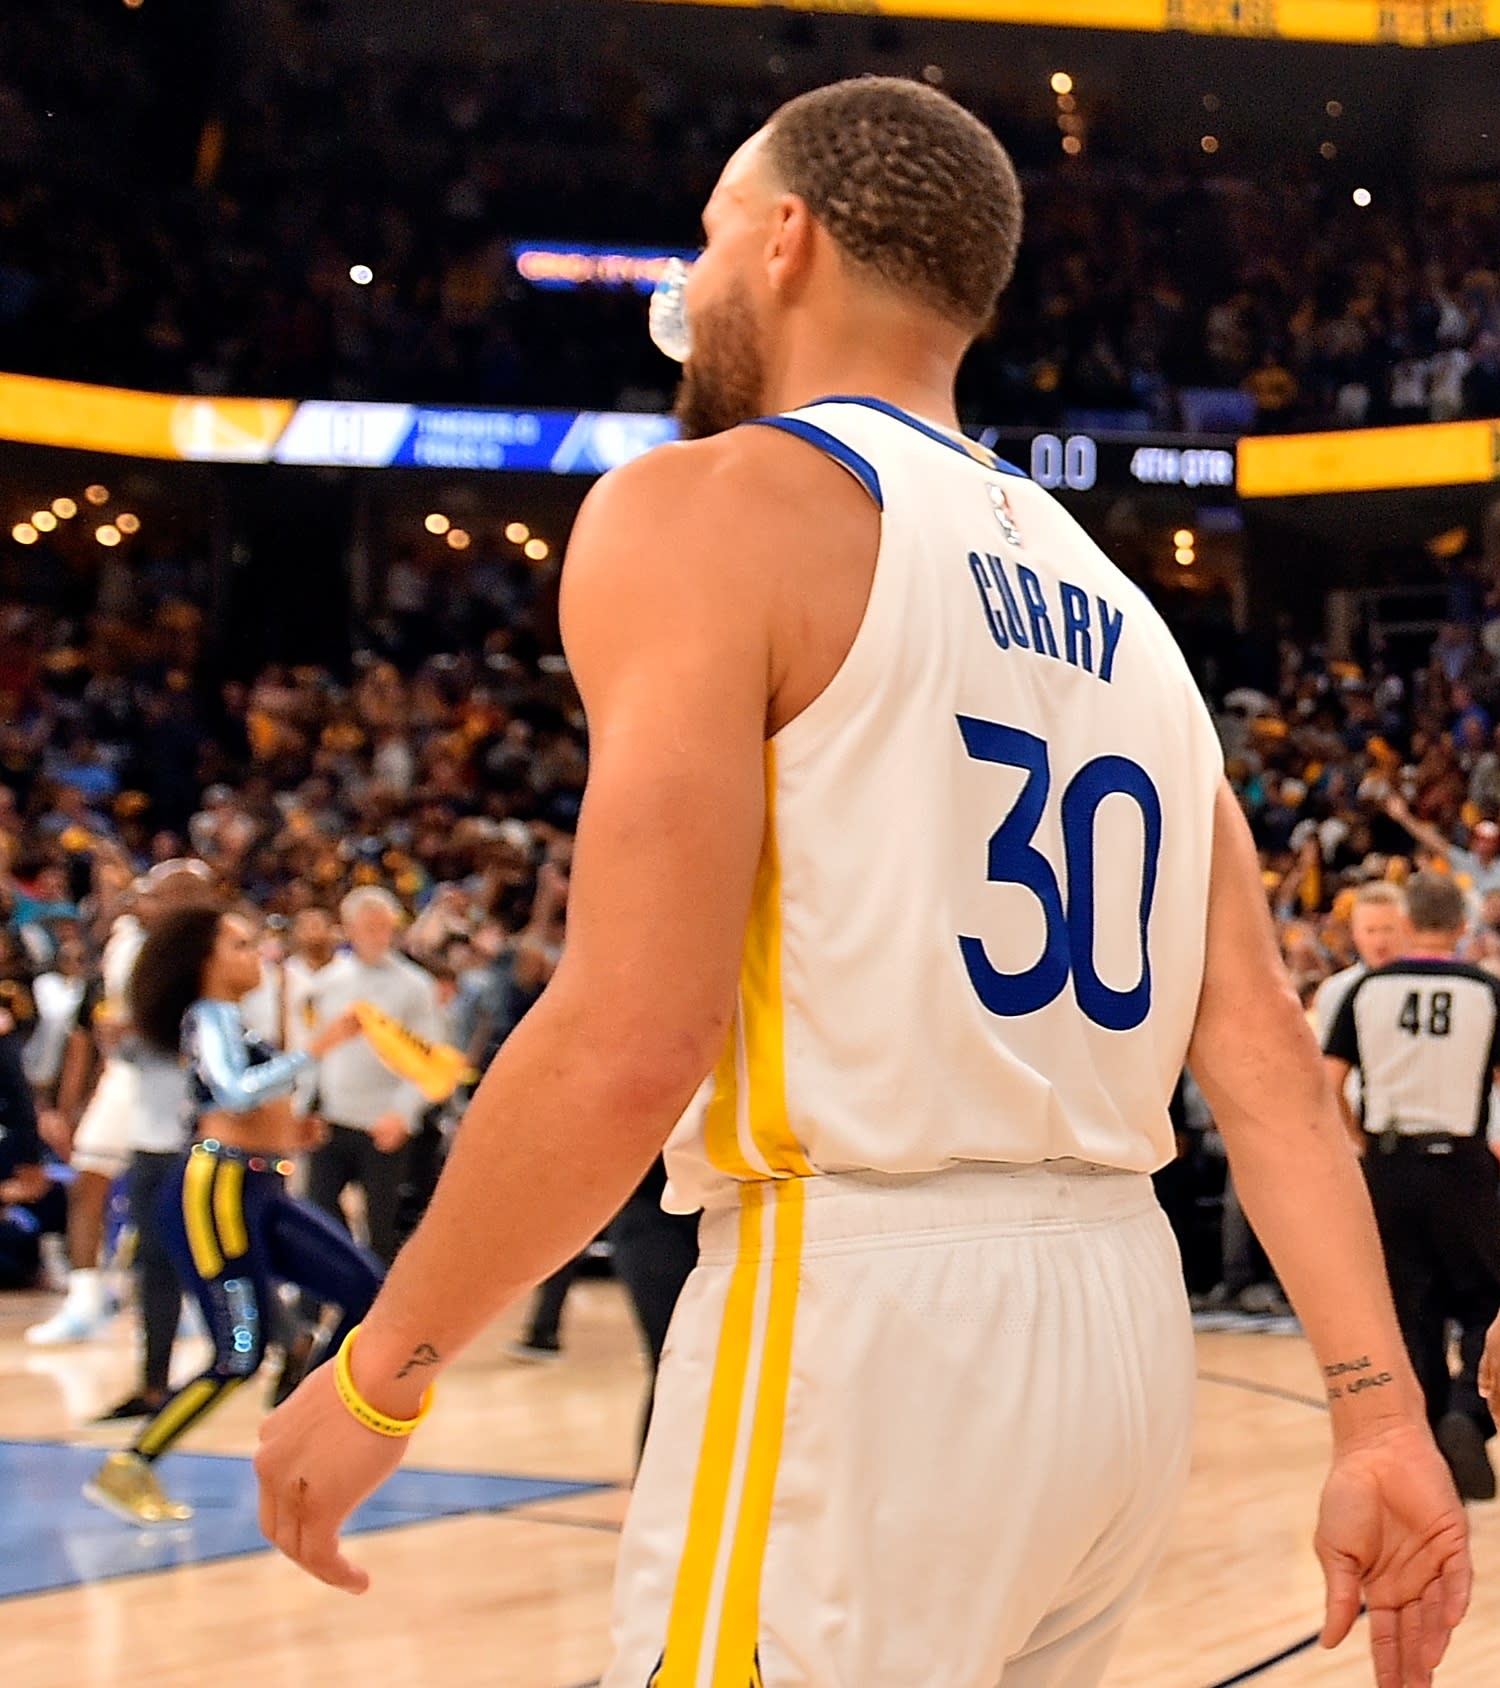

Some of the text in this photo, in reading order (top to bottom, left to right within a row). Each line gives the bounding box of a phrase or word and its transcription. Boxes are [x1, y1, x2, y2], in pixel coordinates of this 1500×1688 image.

[968, 551, 1123, 684] CURRY
[955, 713, 1162, 1032] 30
[1399, 992, 1451, 1035] 48
